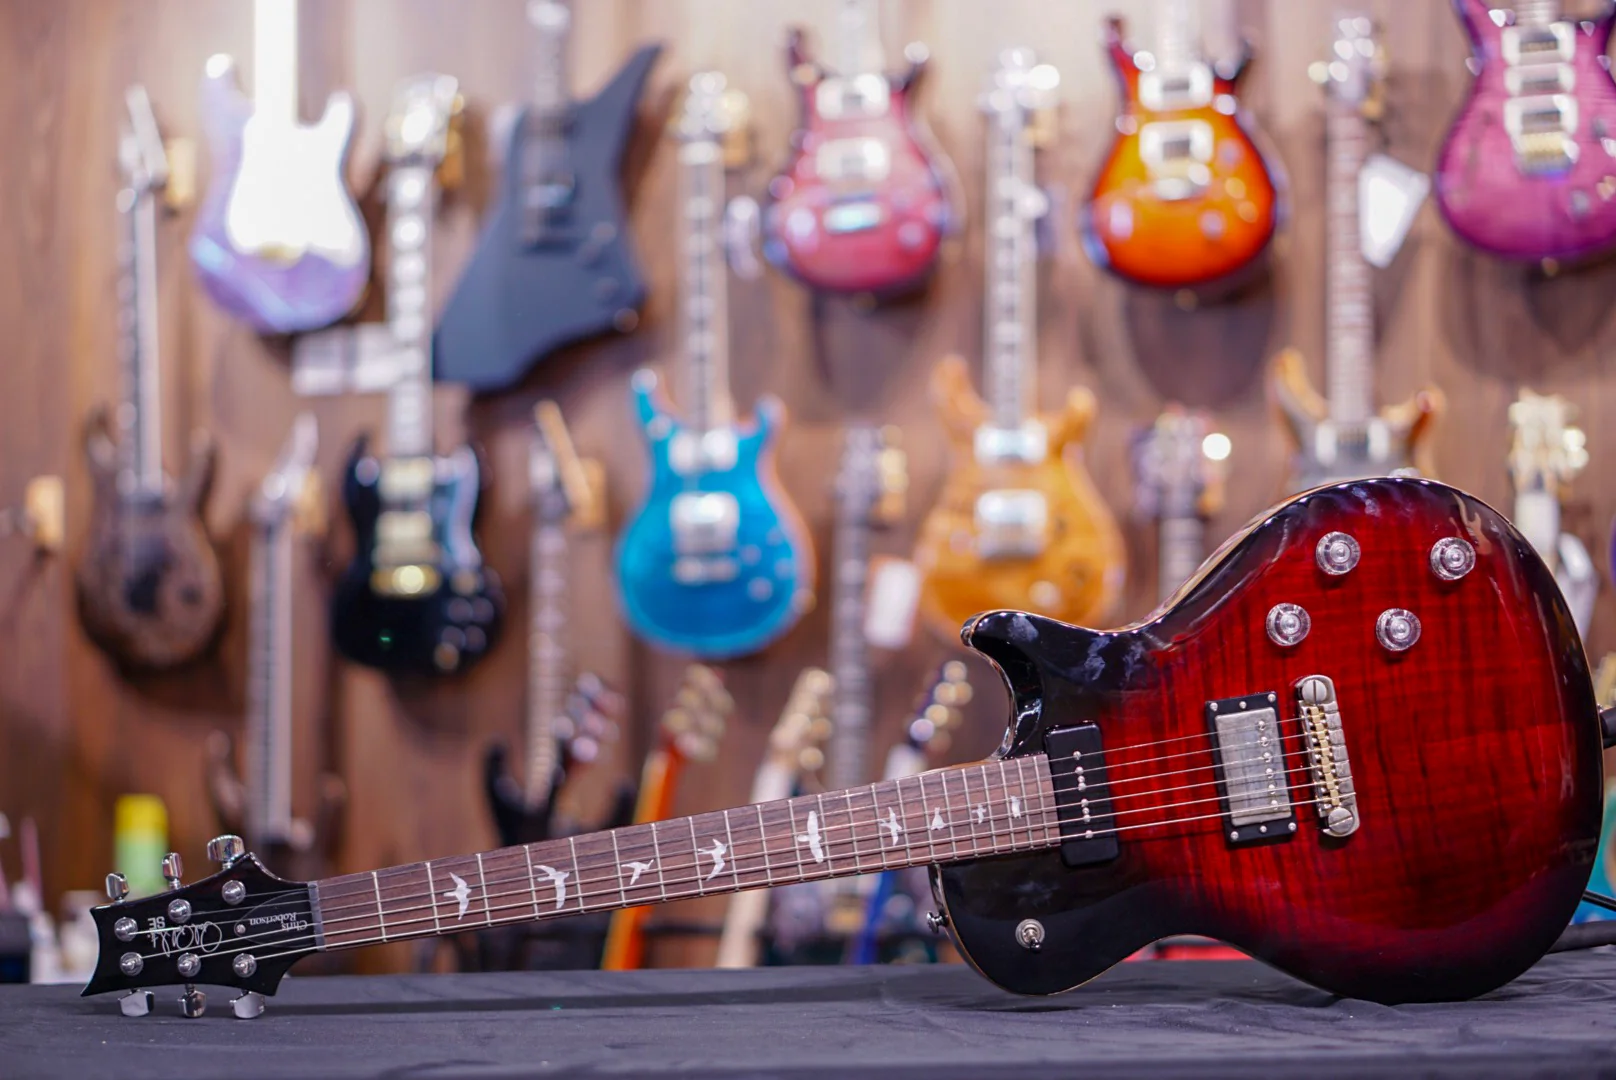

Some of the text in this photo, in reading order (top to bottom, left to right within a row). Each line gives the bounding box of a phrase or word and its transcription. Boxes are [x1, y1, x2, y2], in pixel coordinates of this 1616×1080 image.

[147, 916, 166, 931] SE
[249, 912, 298, 926] Robertson
[281, 920, 308, 932] Chris
